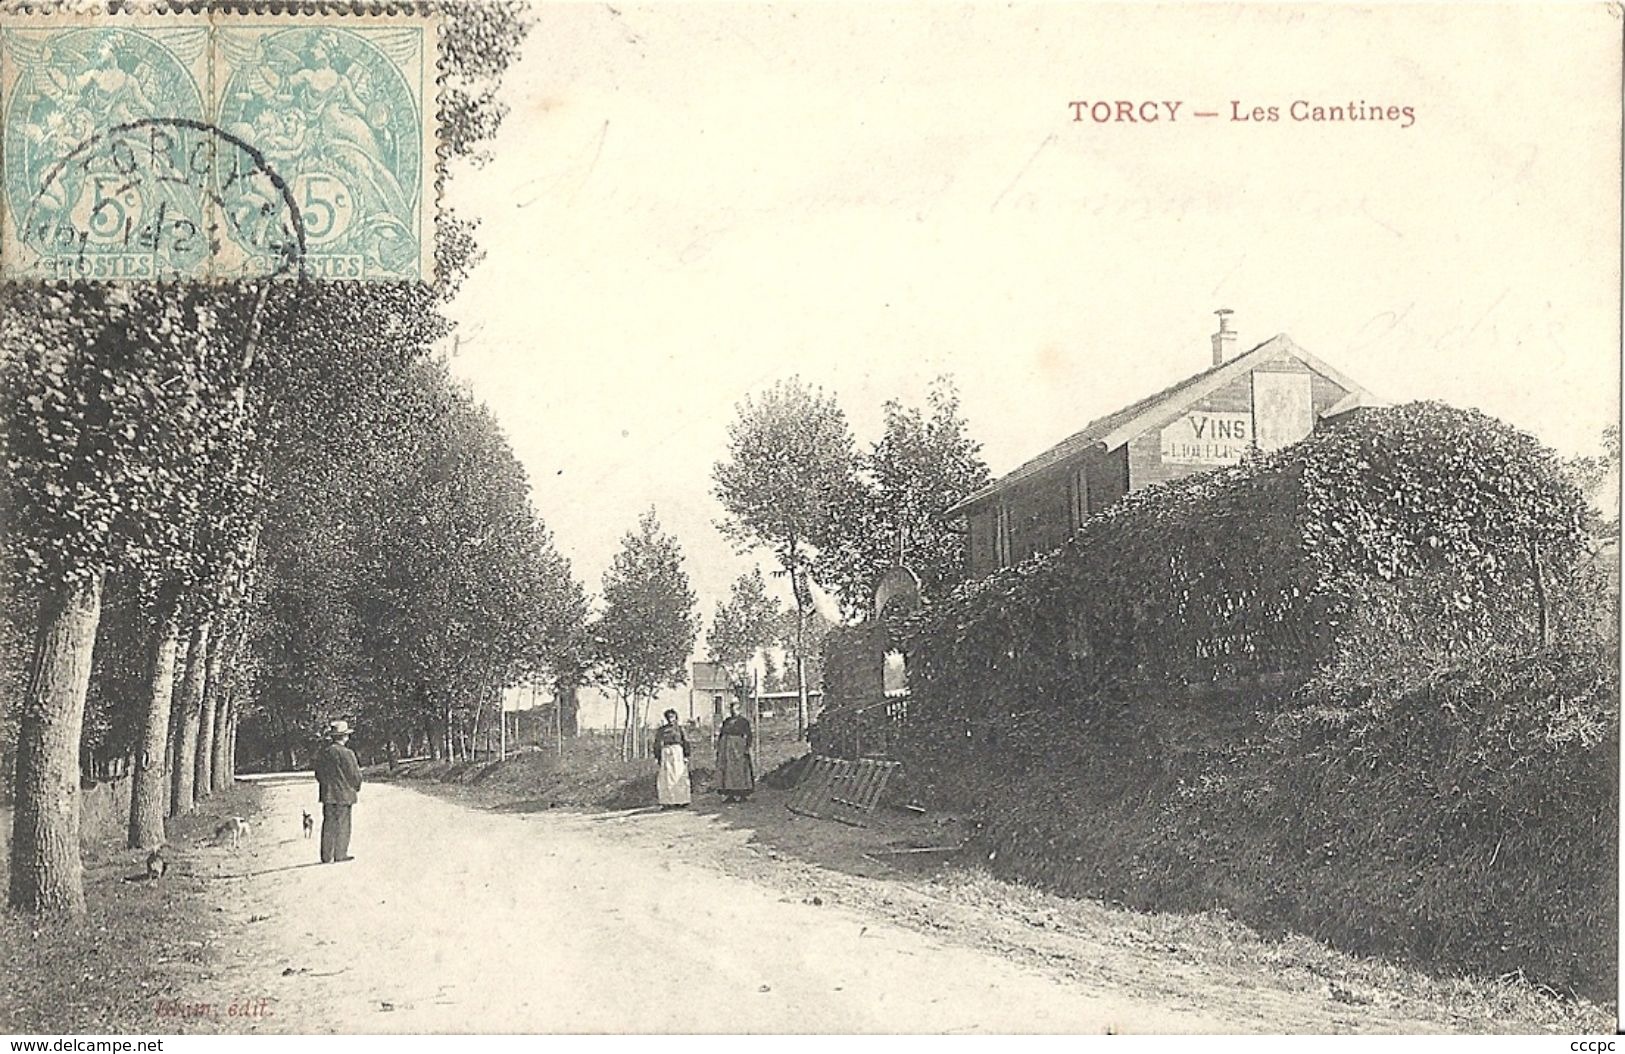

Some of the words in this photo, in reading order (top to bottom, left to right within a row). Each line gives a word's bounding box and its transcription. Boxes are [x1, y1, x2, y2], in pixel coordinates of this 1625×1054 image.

[1068, 100, 1184, 123] TORCY
[1229, 100, 1280, 123] Les
[1289, 99, 1416, 129] Cantines
[1187, 416, 1245, 439] VINS
[227, 997, 274, 1018] édit.
